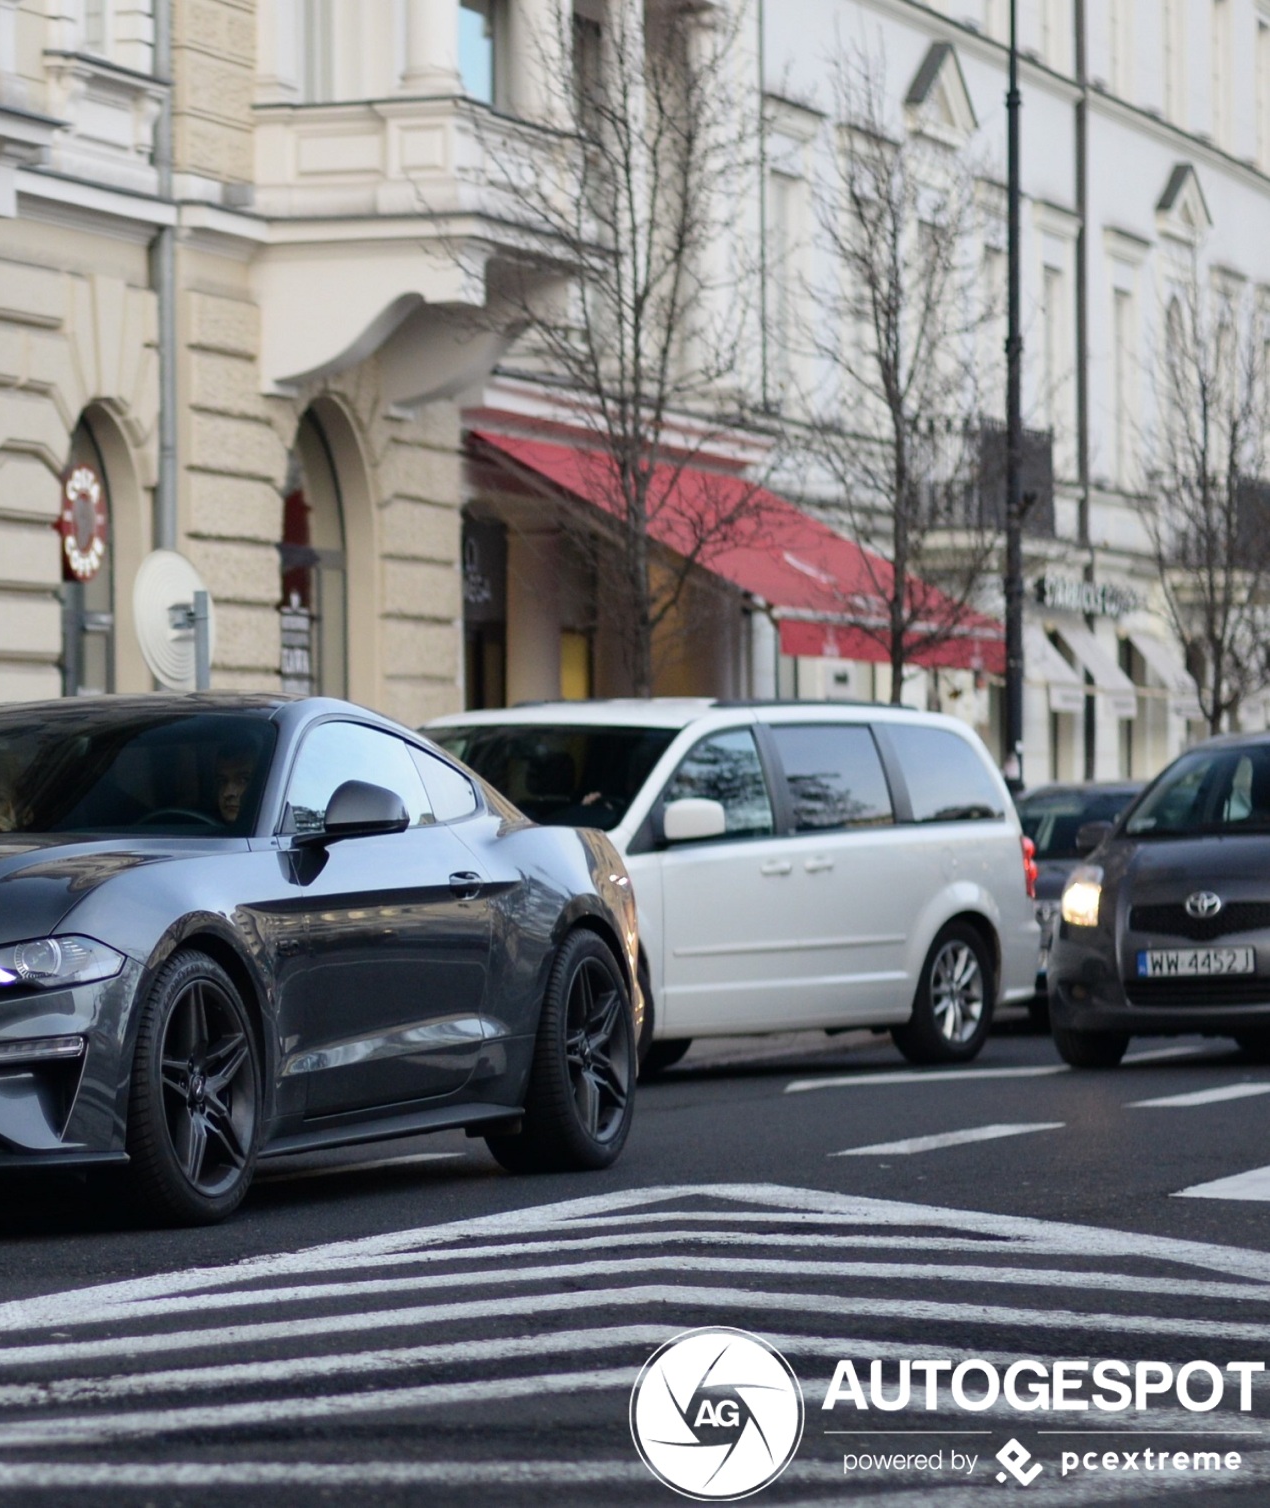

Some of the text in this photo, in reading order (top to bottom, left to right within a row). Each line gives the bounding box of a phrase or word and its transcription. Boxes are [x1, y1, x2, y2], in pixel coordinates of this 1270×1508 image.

[66, 467, 100, 503] COSTA
[65, 535, 104, 577] COFFEE
[1151, 948, 1250, 974] WW 4452J
